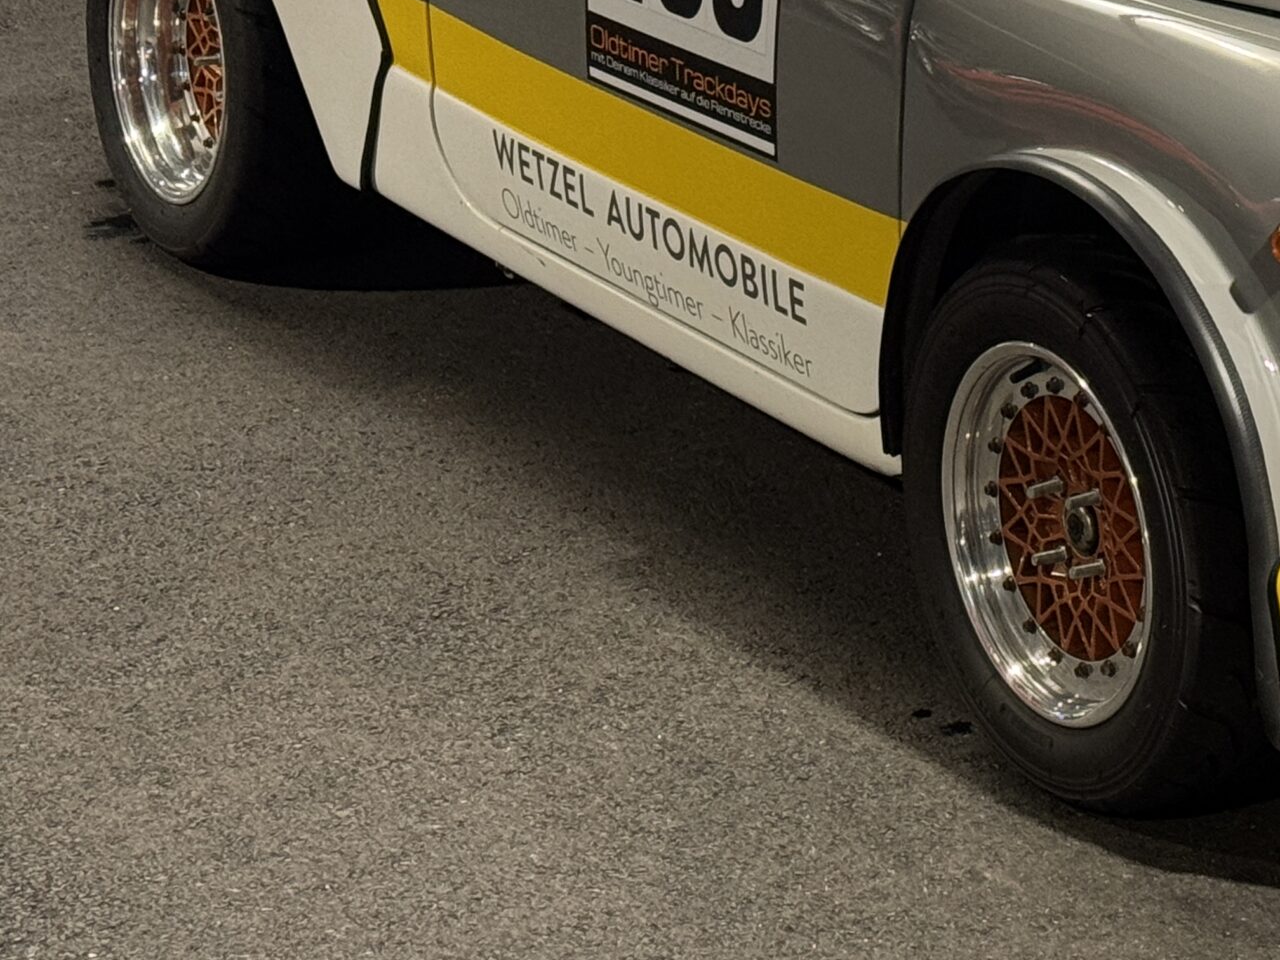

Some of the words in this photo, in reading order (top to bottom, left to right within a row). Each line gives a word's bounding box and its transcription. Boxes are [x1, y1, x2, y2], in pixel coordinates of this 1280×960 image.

[590, 24, 668, 75] Oldtimer
[670, 56, 772, 118] Trackdays
[590, 50, 605, 65] mit
[680, 89, 696, 103] auf
[696, 95, 710, 110] die
[492, 128, 594, 218] WETZEL
[606, 189, 808, 327] AUTOMOBILE
[501, 187, 577, 253] Oldtimer
[596, 236, 704, 321] Youngtimer
[728, 306, 813, 379] Klassiker
